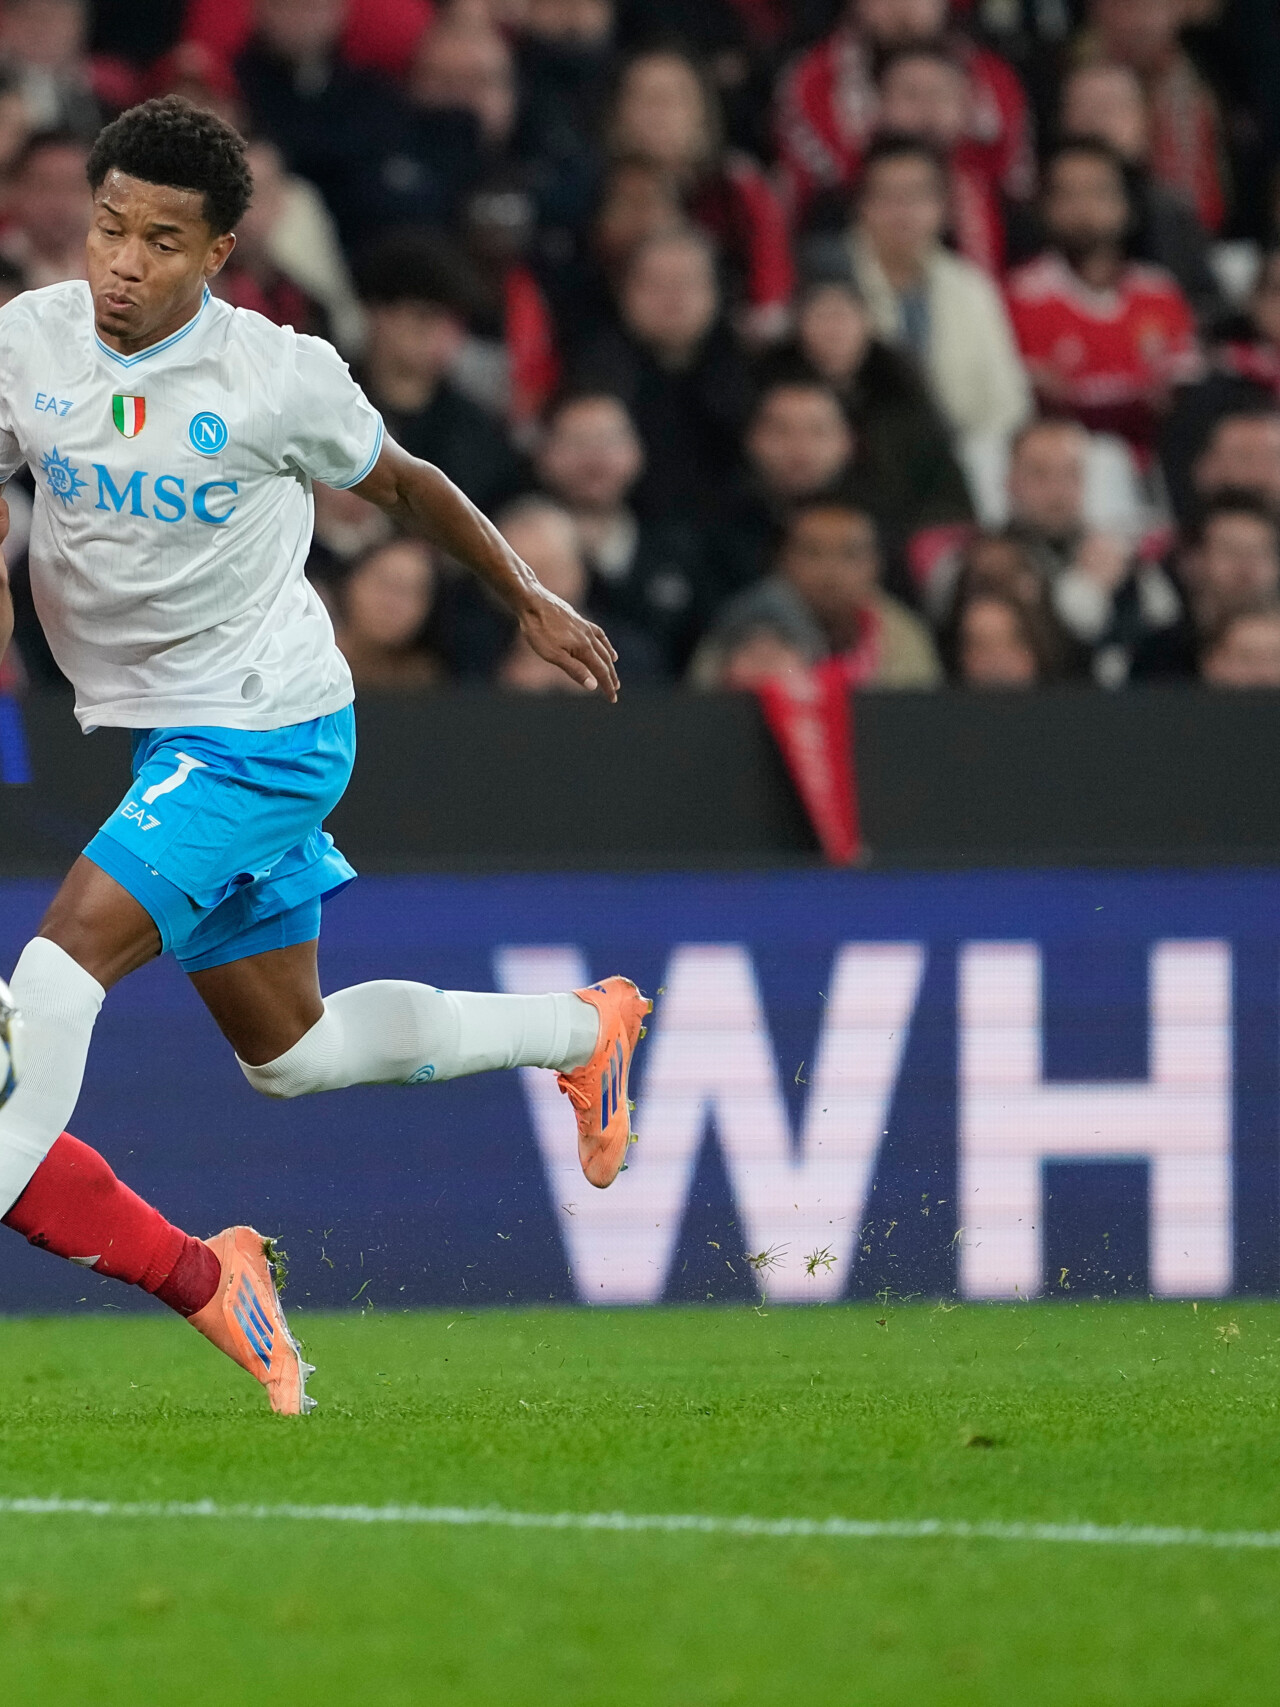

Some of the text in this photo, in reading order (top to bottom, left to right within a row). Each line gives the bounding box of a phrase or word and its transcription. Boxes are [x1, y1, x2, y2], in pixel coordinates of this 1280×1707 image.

[34, 392, 74, 417] EA7
[199, 421, 219, 444] N
[92, 463, 239, 525] MSC
[141, 752, 210, 805] 7
[121, 801, 161, 831] EA7
[492, 939, 1234, 1305] WH
